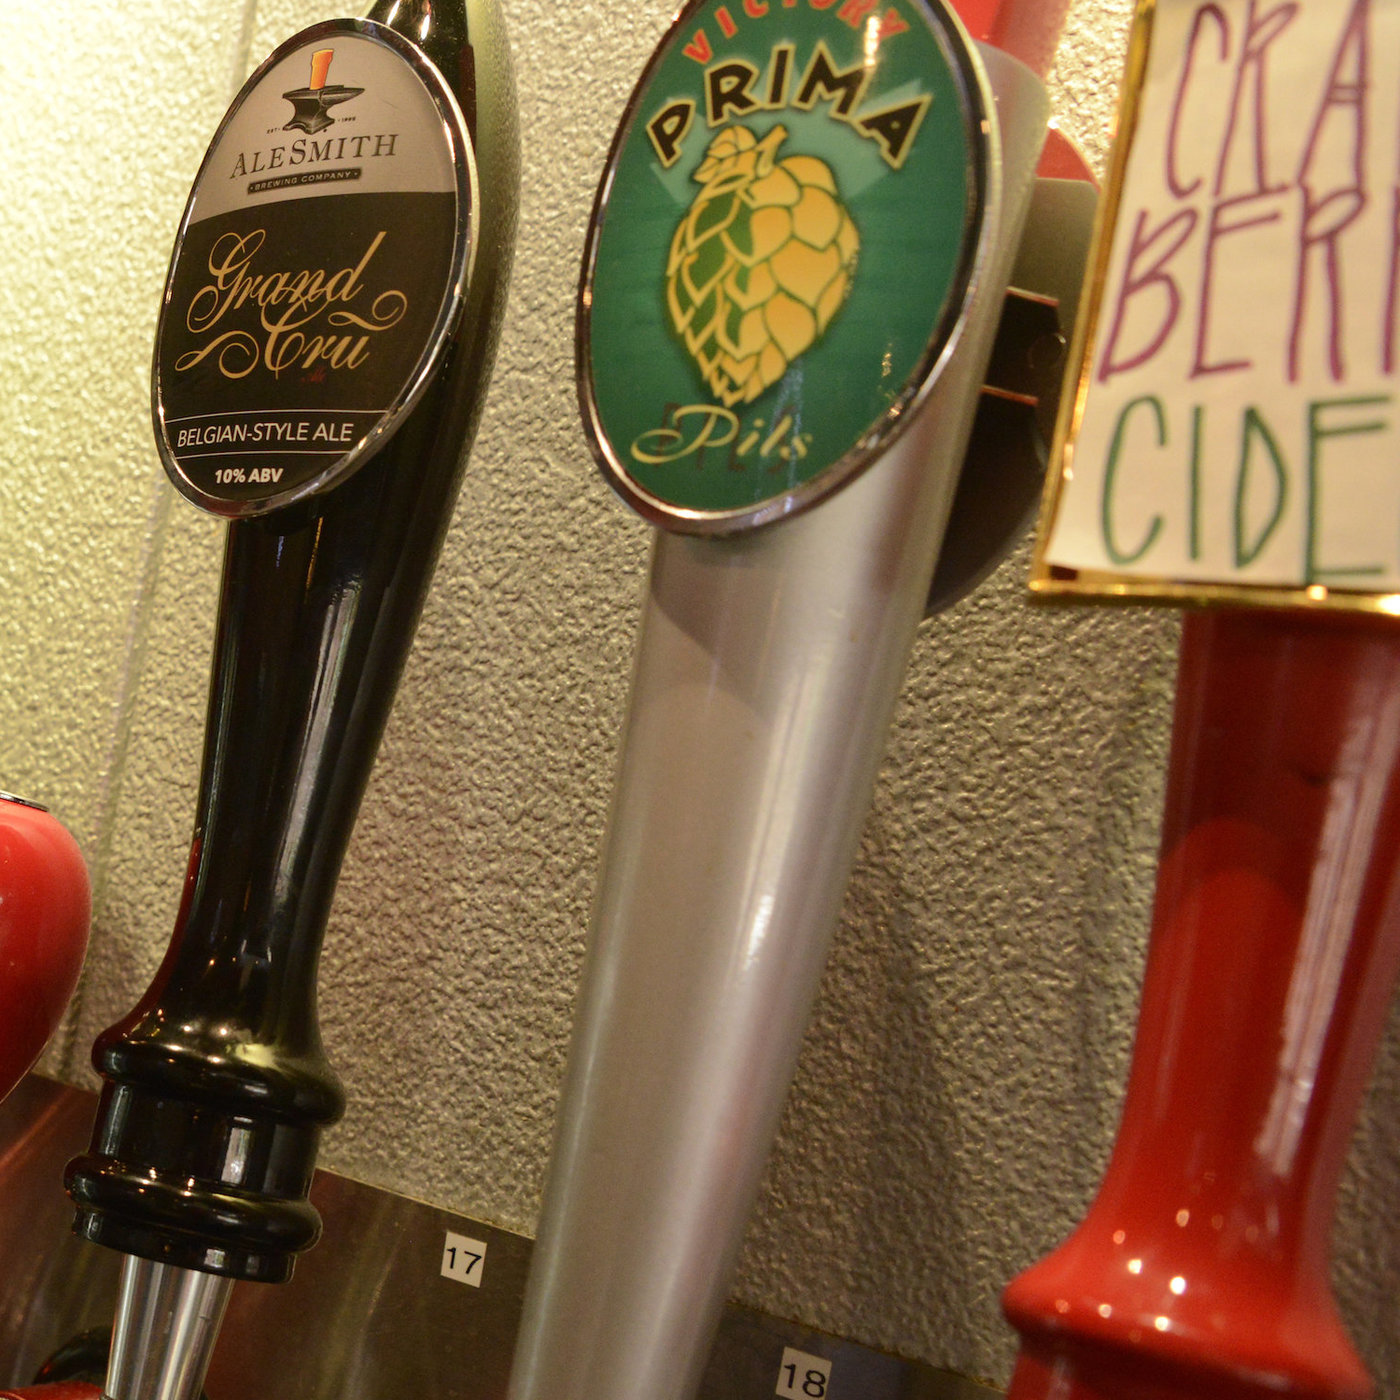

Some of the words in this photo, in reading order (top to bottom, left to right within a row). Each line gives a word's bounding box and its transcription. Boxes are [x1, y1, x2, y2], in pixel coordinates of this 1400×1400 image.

[682, 0, 911, 65] VICRY
[645, 38, 933, 170] PRIMA
[1165, 0, 1400, 199] CRA
[254, 176, 298, 192] BREWING
[301, 170, 351, 184] COMPANY
[186, 228, 388, 334] Grand
[1096, 184, 1400, 385] BER
[177, 422, 310, 448] BELGIAN-STYLE
[312, 422, 355, 442] ALE
[631, 403, 814, 465] Pils
[215, 468, 246, 484] 10%
[248, 467, 284, 484] ABV
[1100, 395, 1400, 586] CIDE
[446, 1246, 482, 1274] 17
[783, 1363, 826, 1398] 18
